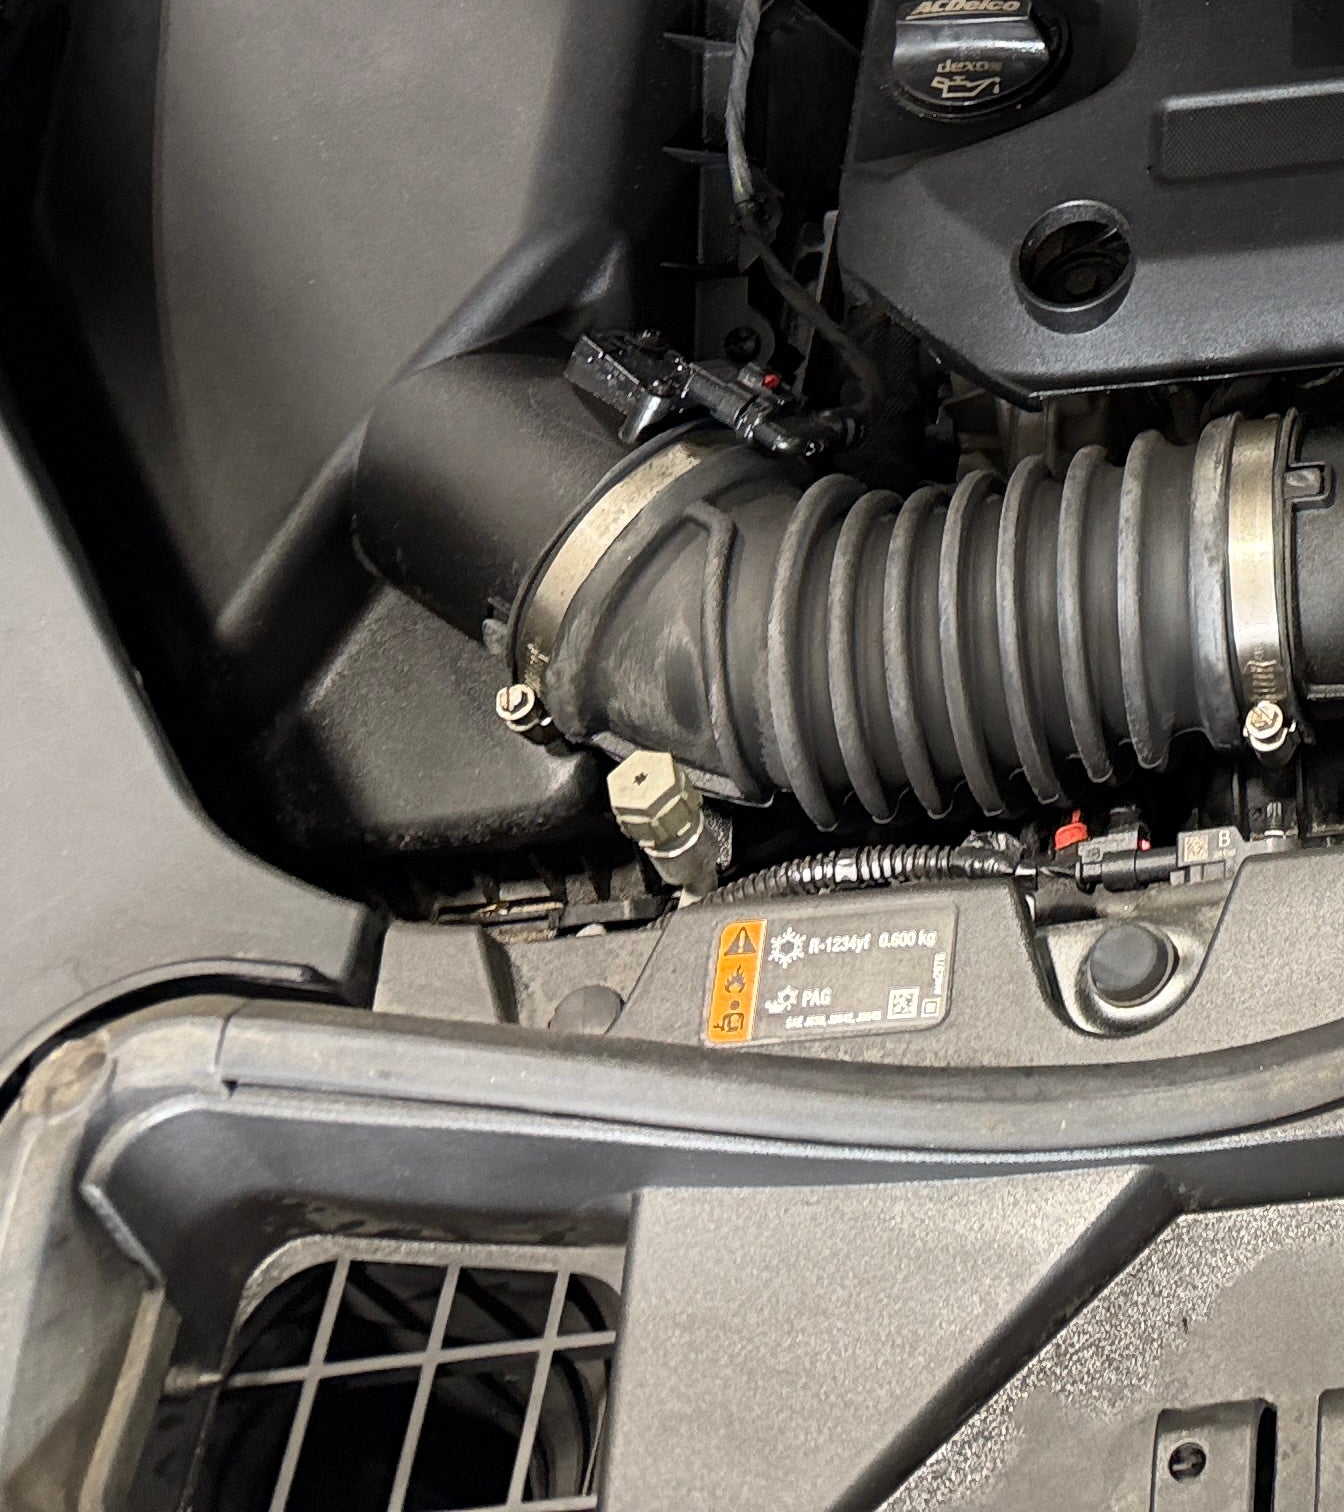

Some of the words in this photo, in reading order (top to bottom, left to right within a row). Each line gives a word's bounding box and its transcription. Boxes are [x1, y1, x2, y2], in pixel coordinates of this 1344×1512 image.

[1218, 829, 1231, 848] B
[808, 932, 871, 955] R-1234yf
[878, 929, 917, 948] 0.600
[918, 929, 936, 947] kg
[801, 986, 833, 1008] PAG
